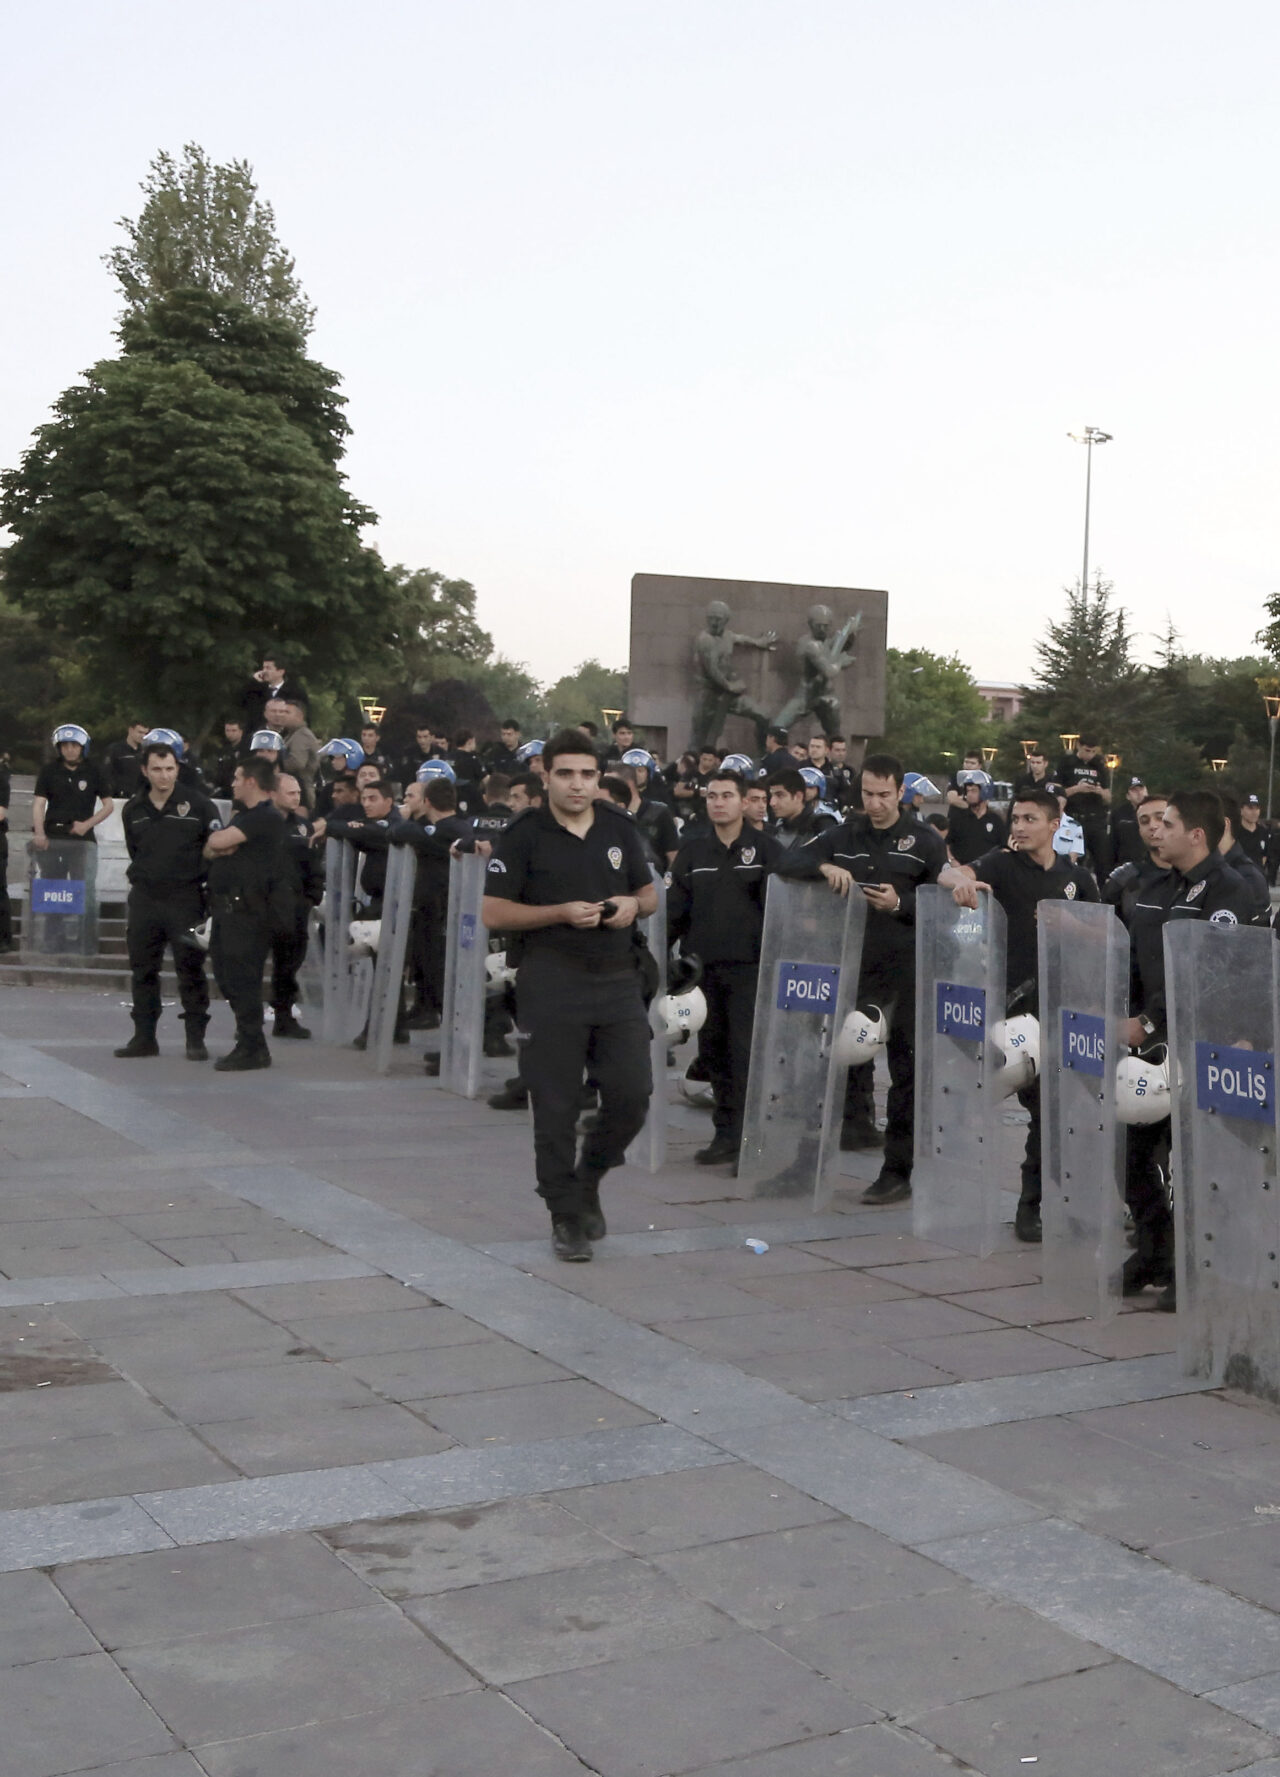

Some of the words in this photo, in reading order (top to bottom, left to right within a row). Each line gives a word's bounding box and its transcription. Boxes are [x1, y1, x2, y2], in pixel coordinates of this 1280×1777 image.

[44, 890, 73, 902] POLİS
[786, 978, 831, 1001] POLİS
[678, 1008, 691, 1017] 90
[944, 1001, 982, 1026] POLİS
[856, 1029, 868, 1044] 90
[1010, 1033, 1026, 1048] 90
[1069, 1032, 1105, 1061] POLİS
[1135, 1079, 1148, 1097] 90
[1208, 1065, 1266, 1101] POLİS
